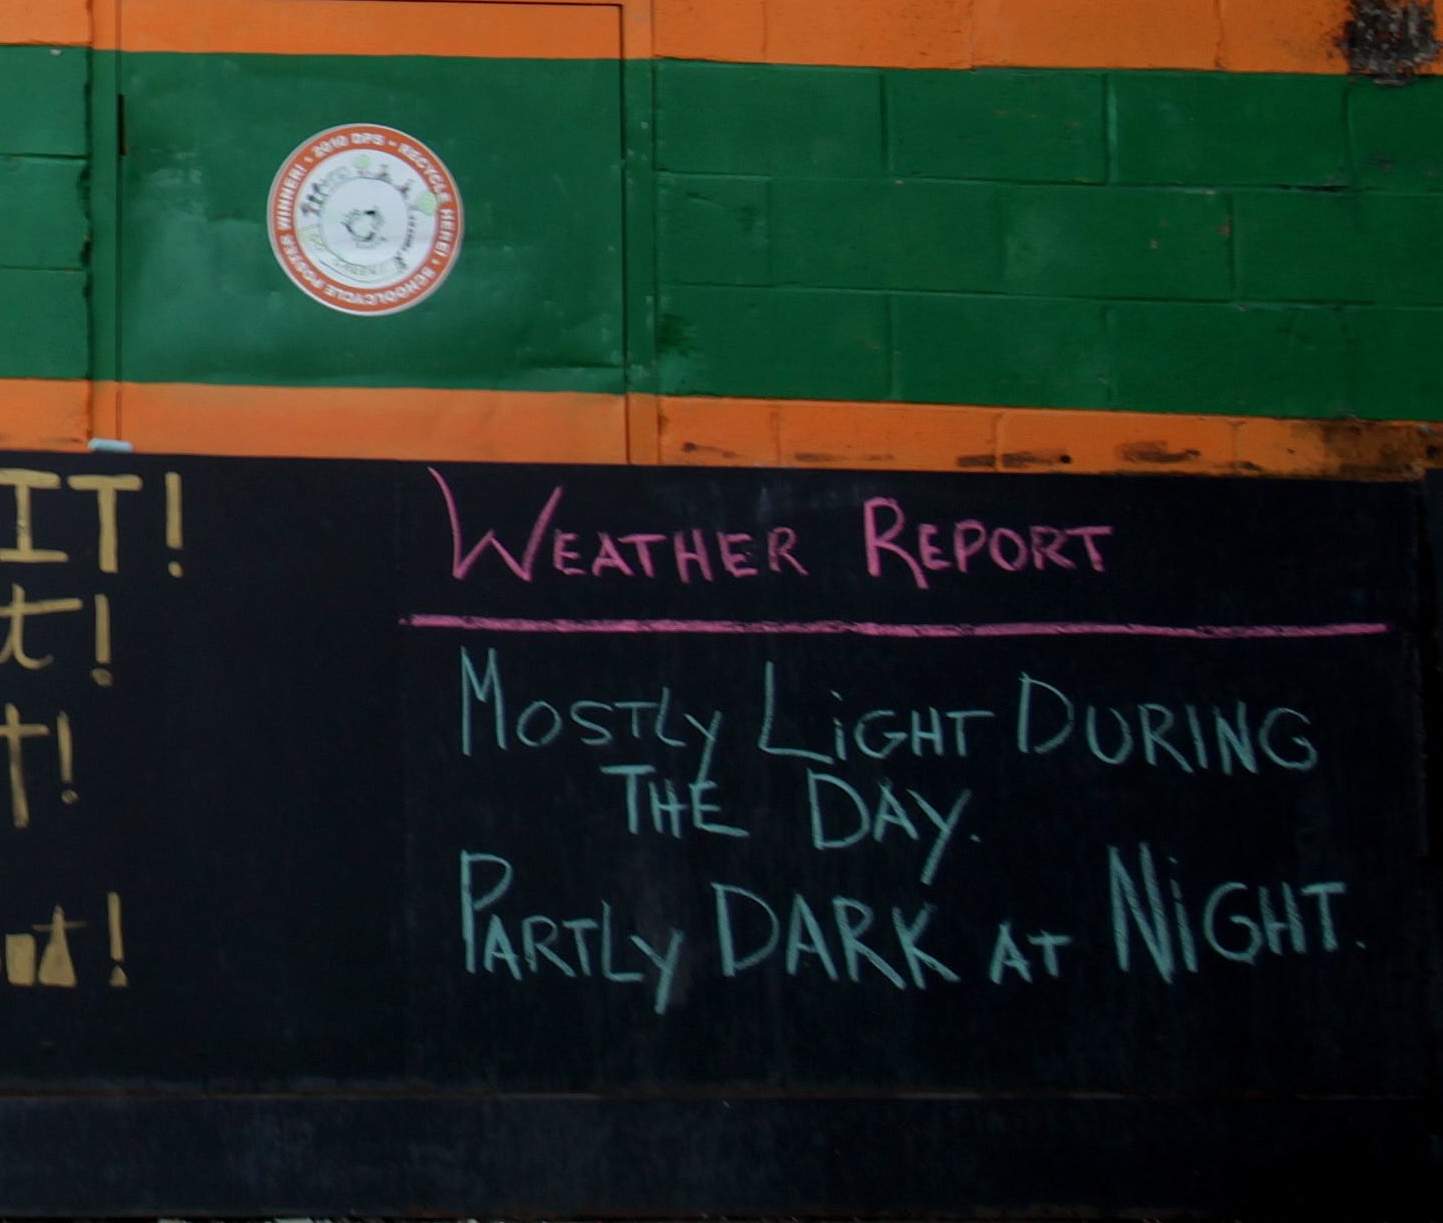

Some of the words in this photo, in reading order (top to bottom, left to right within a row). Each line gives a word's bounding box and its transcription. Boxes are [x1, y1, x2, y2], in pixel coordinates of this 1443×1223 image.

[1017, 671, 1319, 775] DURING
[600, 762, 749, 841] THE
[713, 882, 964, 991] DARK
[987, 920, 1071, 986] AT
